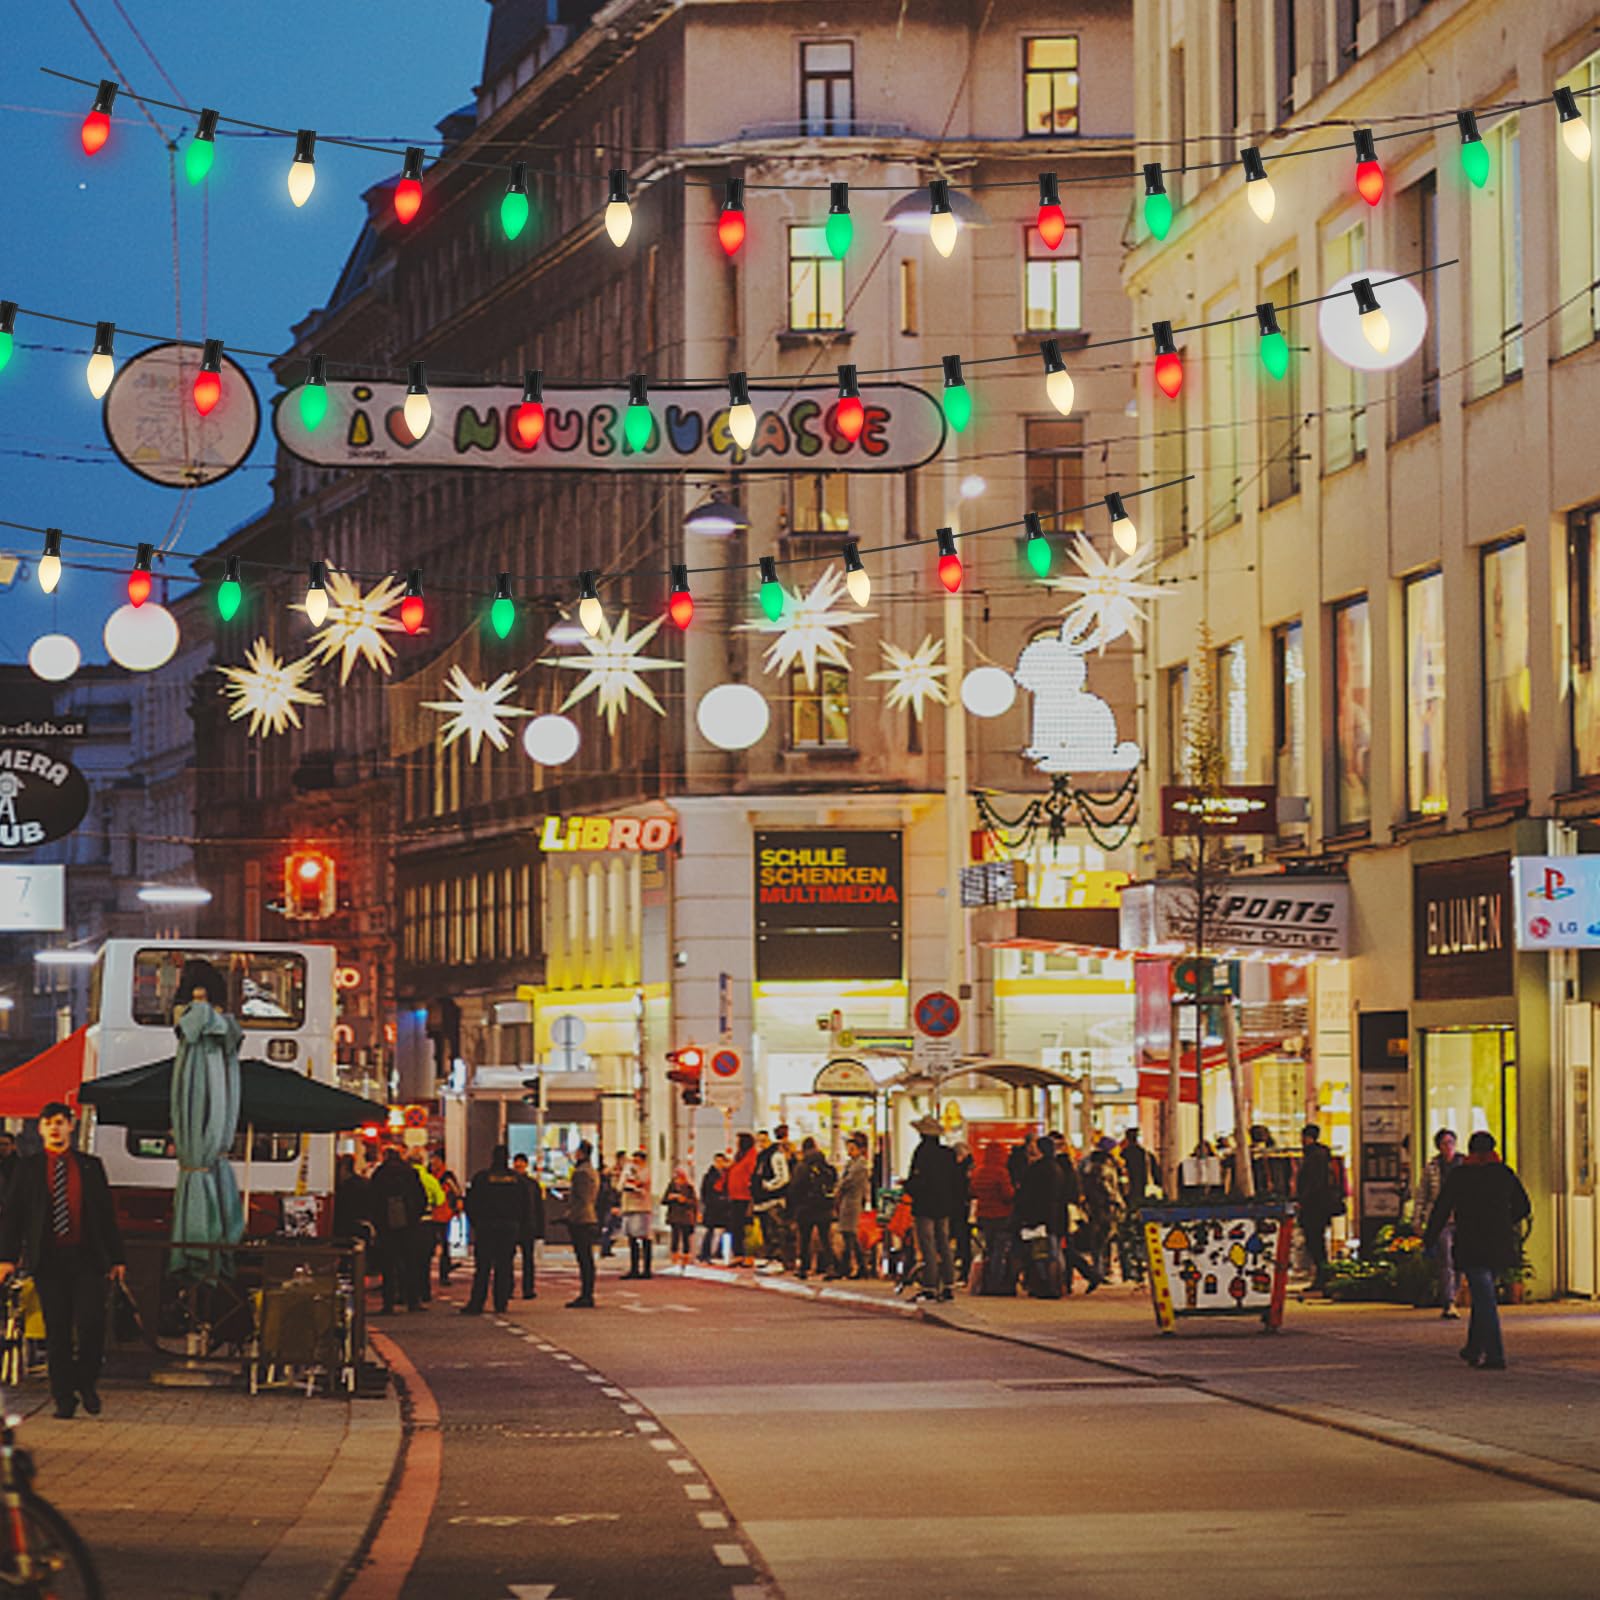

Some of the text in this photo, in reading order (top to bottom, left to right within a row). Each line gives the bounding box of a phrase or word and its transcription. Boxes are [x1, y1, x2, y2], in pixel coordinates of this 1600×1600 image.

[760, 847, 847, 867] SCHULE
[760, 867, 887, 886] SCHENKEN
[760, 885, 899, 905] MULTIMEDIA
[1201, 894, 1335, 924] SPORTS
[1169, 921, 1256, 940] FATORY
[1558, 920, 1579, 935] LG
